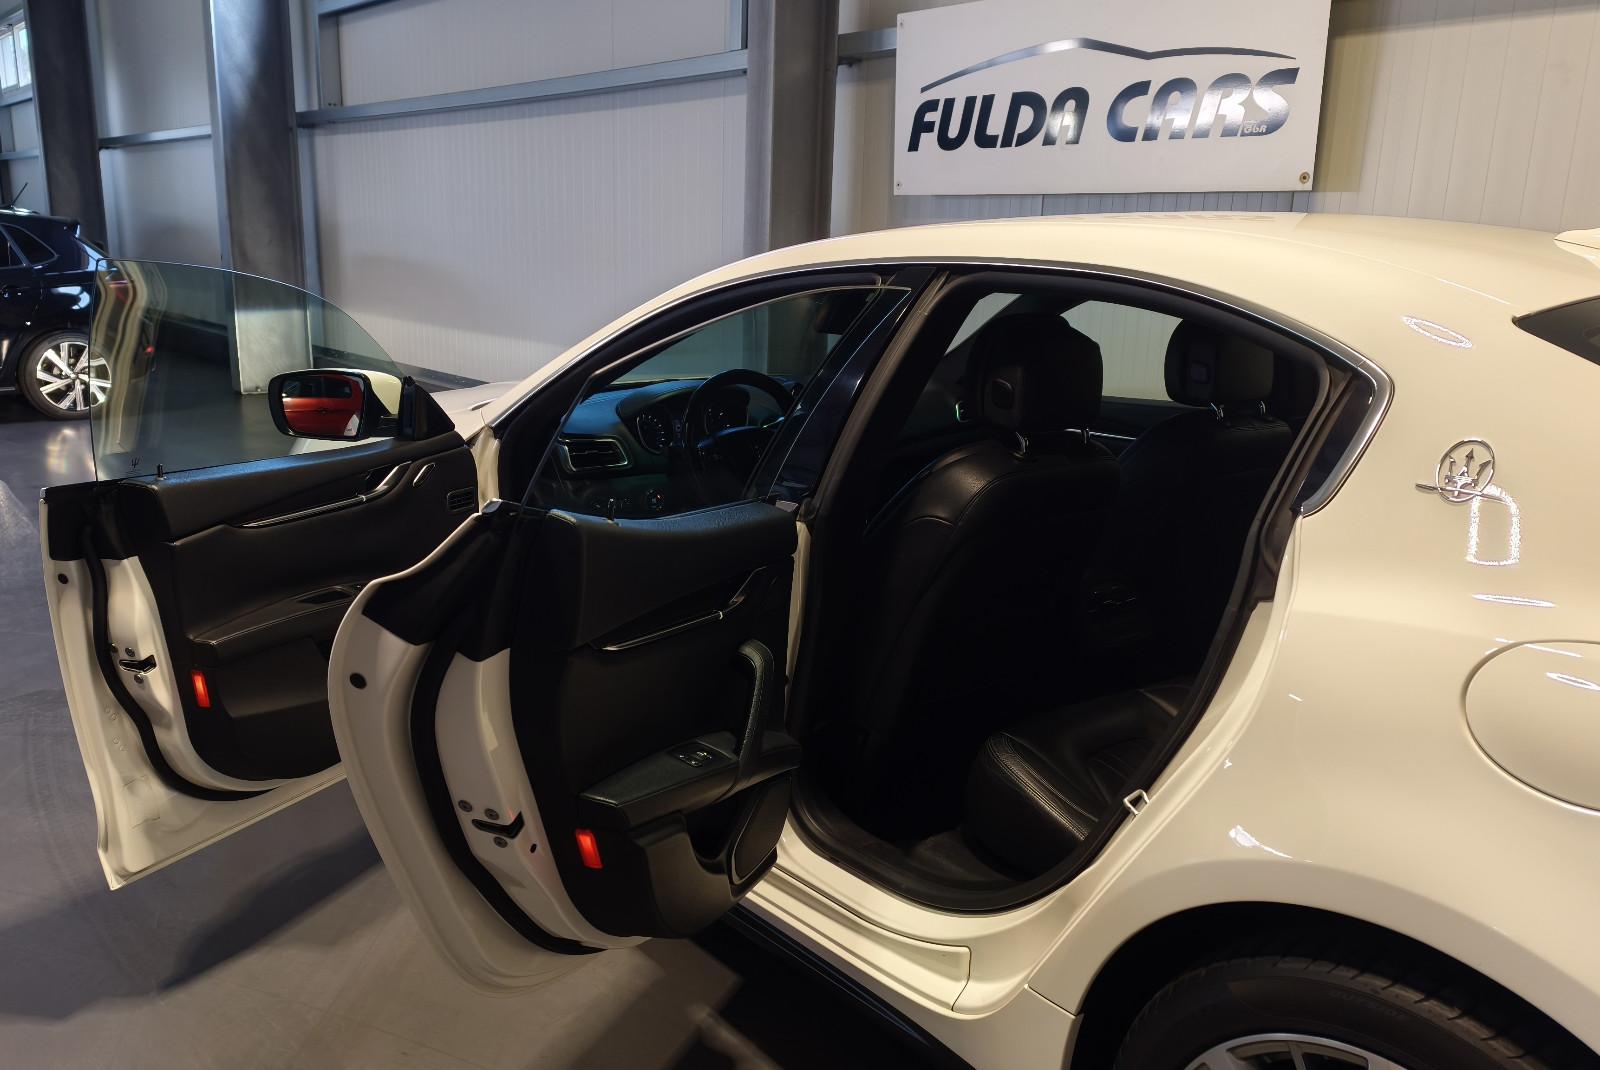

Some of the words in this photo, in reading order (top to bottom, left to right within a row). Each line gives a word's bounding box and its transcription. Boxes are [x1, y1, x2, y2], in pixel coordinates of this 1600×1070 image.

[907, 86, 1090, 152] FULDA
[1106, 67, 1300, 142] CARS
[1243, 124, 1267, 133] GbR
